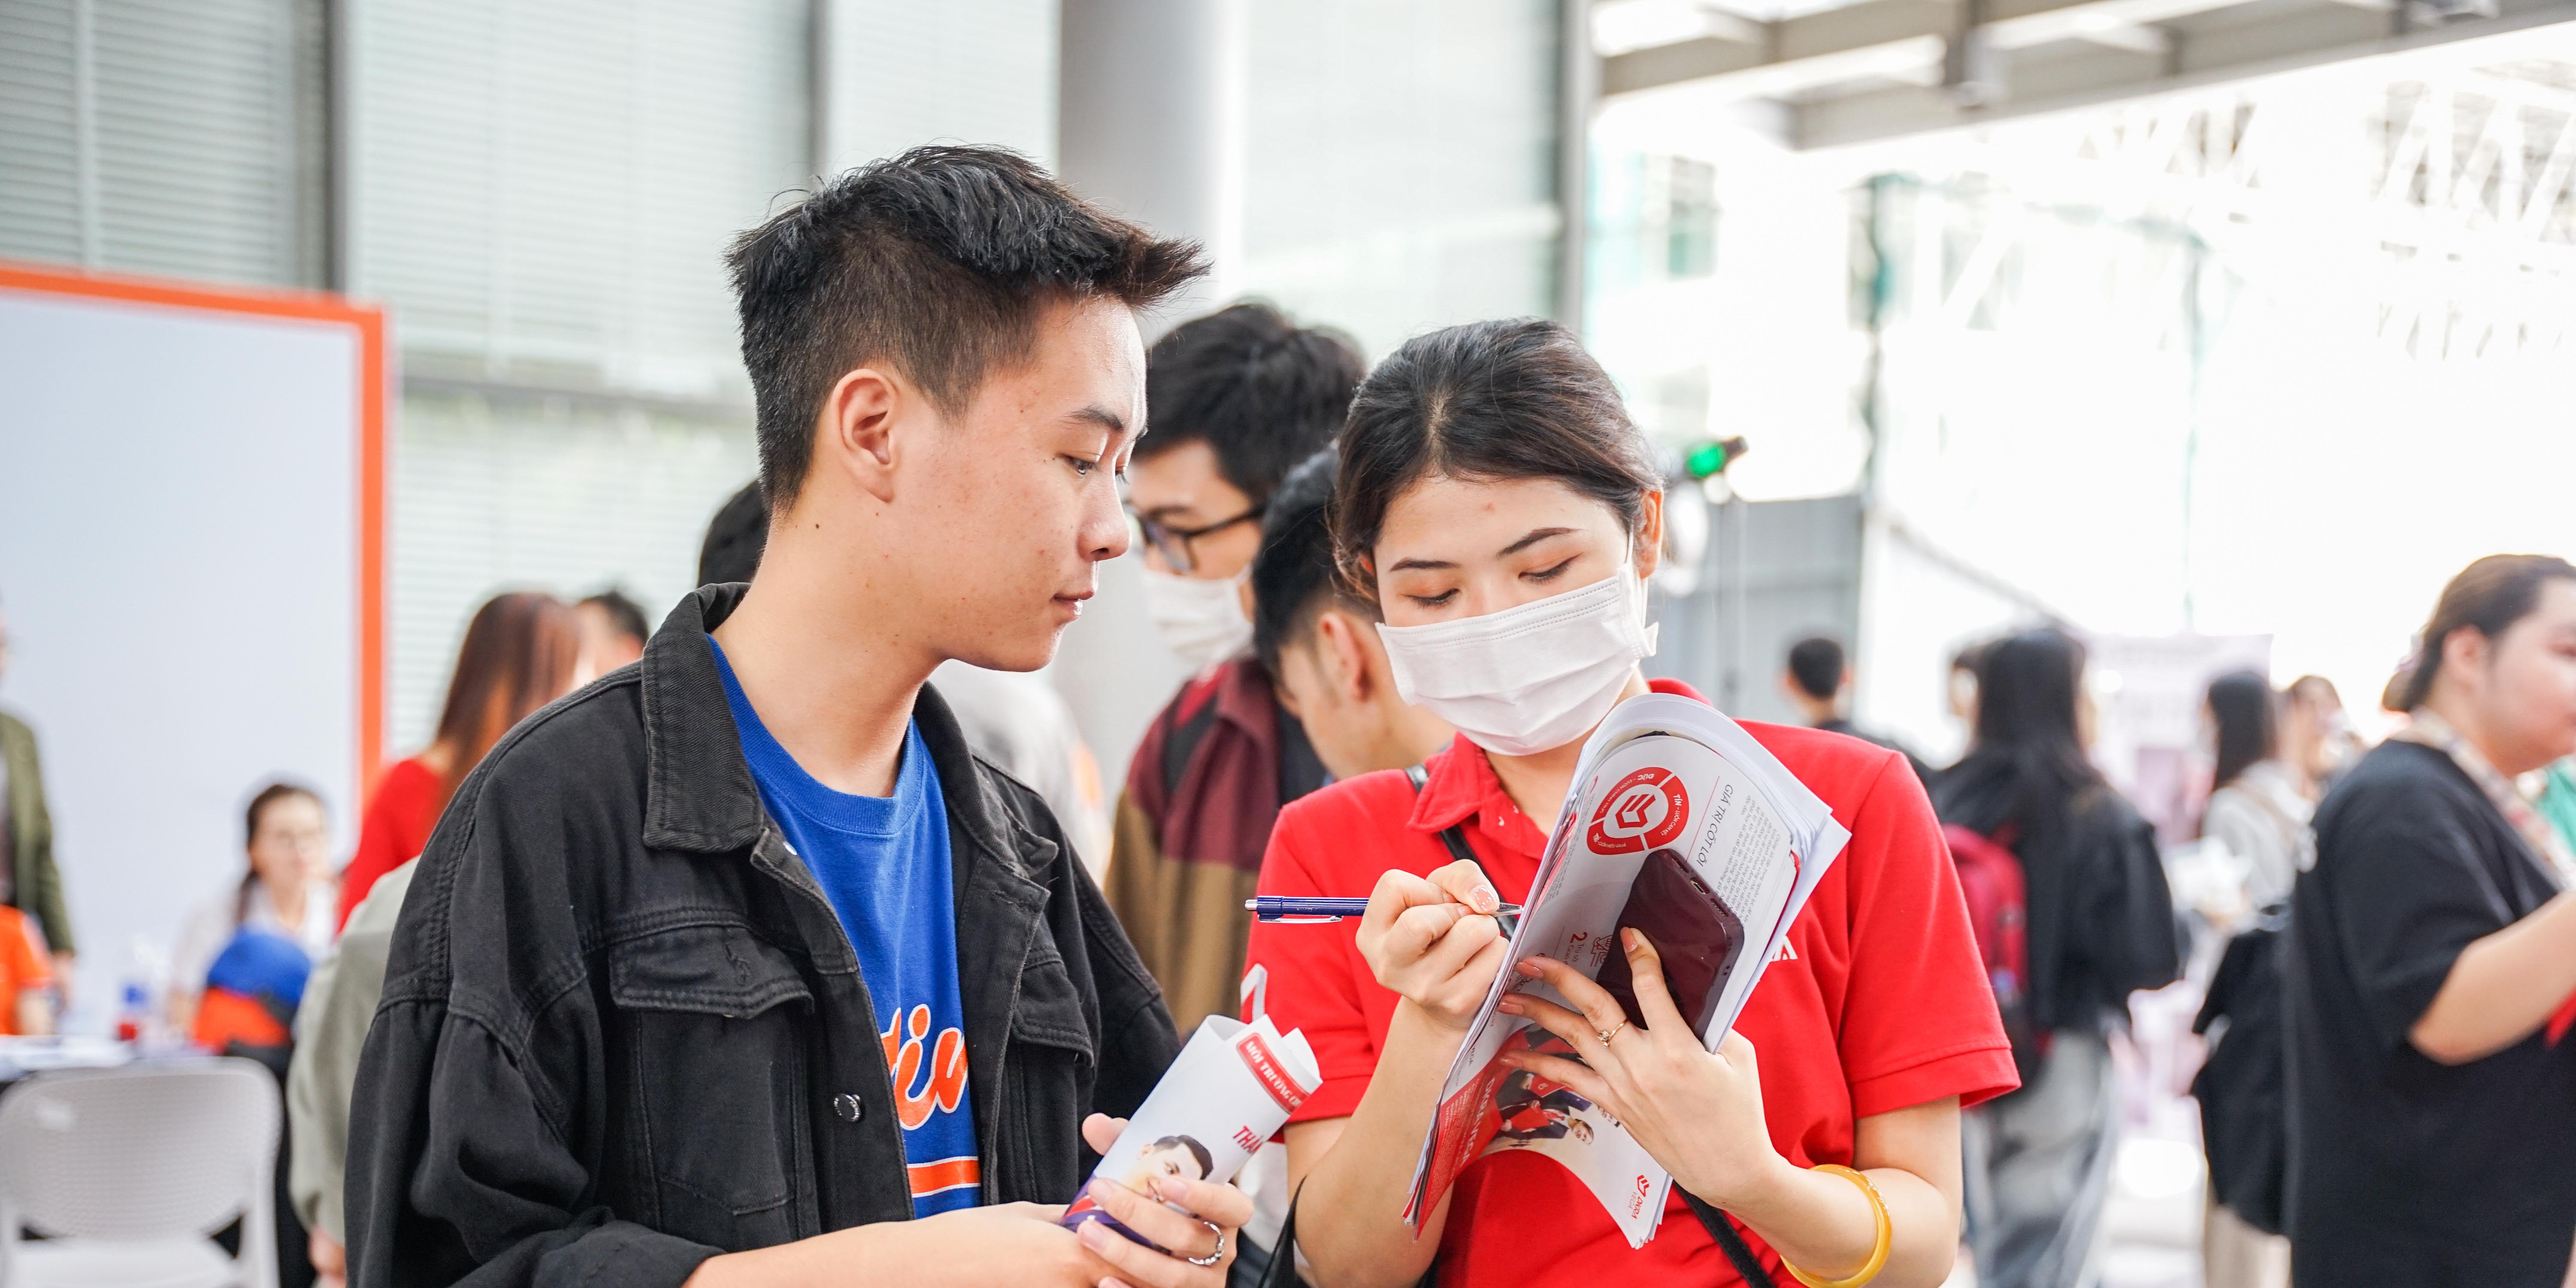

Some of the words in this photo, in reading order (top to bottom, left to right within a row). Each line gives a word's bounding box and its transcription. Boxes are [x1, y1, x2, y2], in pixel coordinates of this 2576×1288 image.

[1673, 794, 1683, 806] TÍN
[1721, 784, 1733, 806] GIÁ
[1711, 805, 1726, 823] TRỊ
[1667, 822, 1676, 831] CAM
[1704, 823, 1718, 848] CỐT
[1696, 847, 1709, 866] LÕI
[1570, 932, 1587, 943] 2
[1246, 1041, 1264, 1063] MÔI
[1631, 1196, 1643, 1219] DKRA
